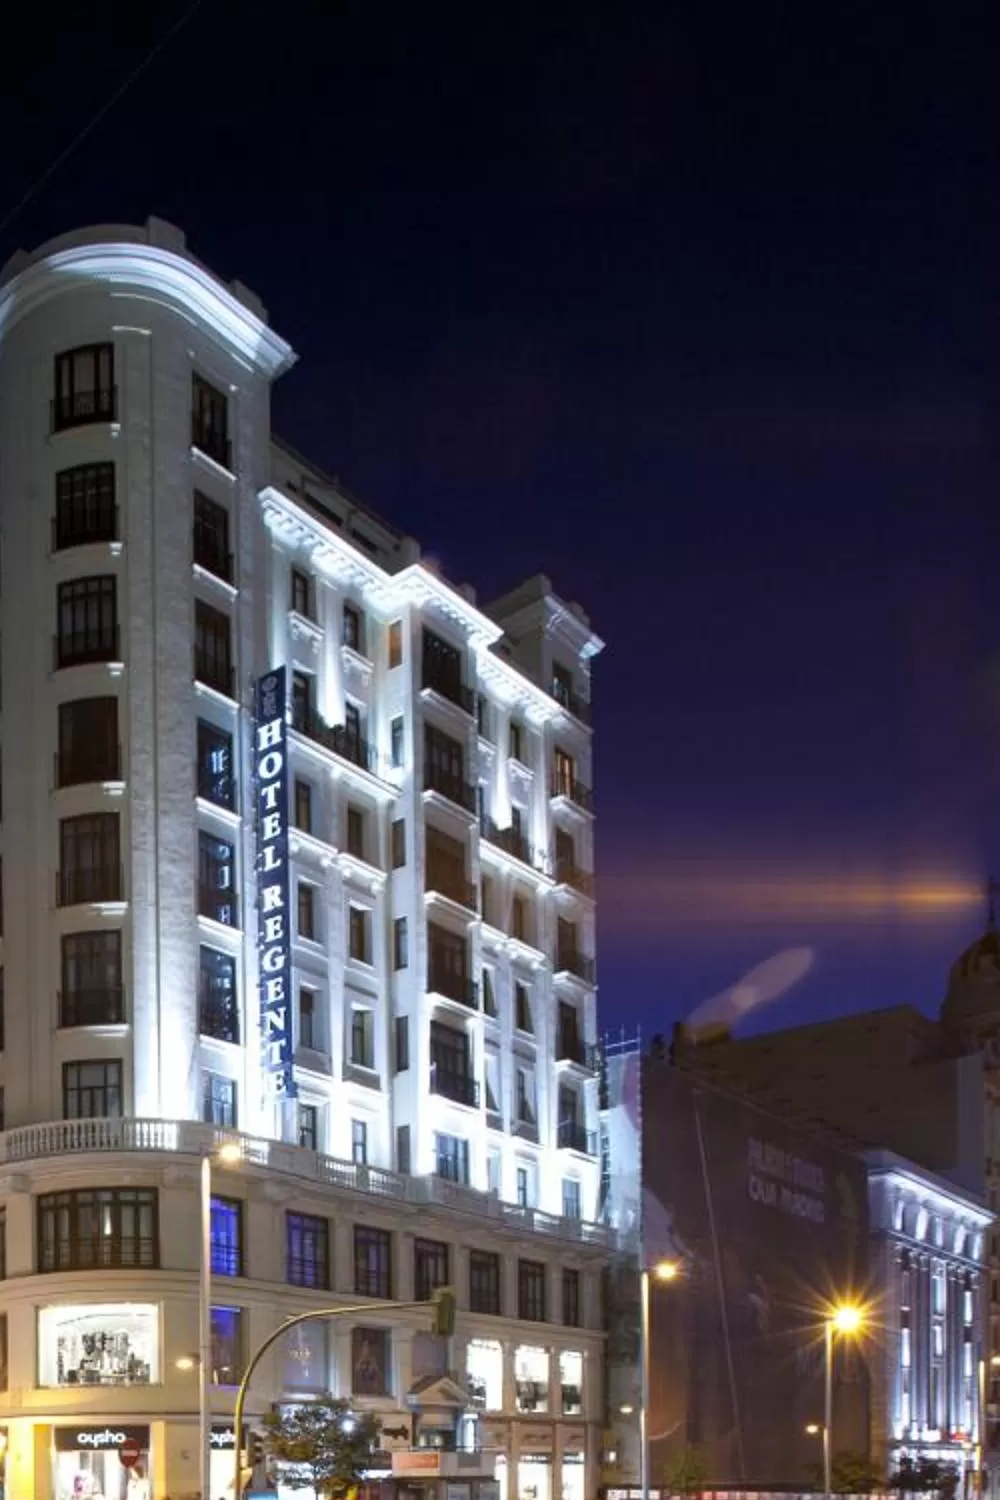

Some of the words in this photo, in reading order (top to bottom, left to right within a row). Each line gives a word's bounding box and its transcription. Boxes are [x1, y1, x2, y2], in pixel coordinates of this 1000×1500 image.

[257, 717, 282, 873] HOTEL
[261, 885, 287, 1094] REGENTE
[77, 1429, 126, 1448] oysho
[209, 1429, 237, 1448] oysh
